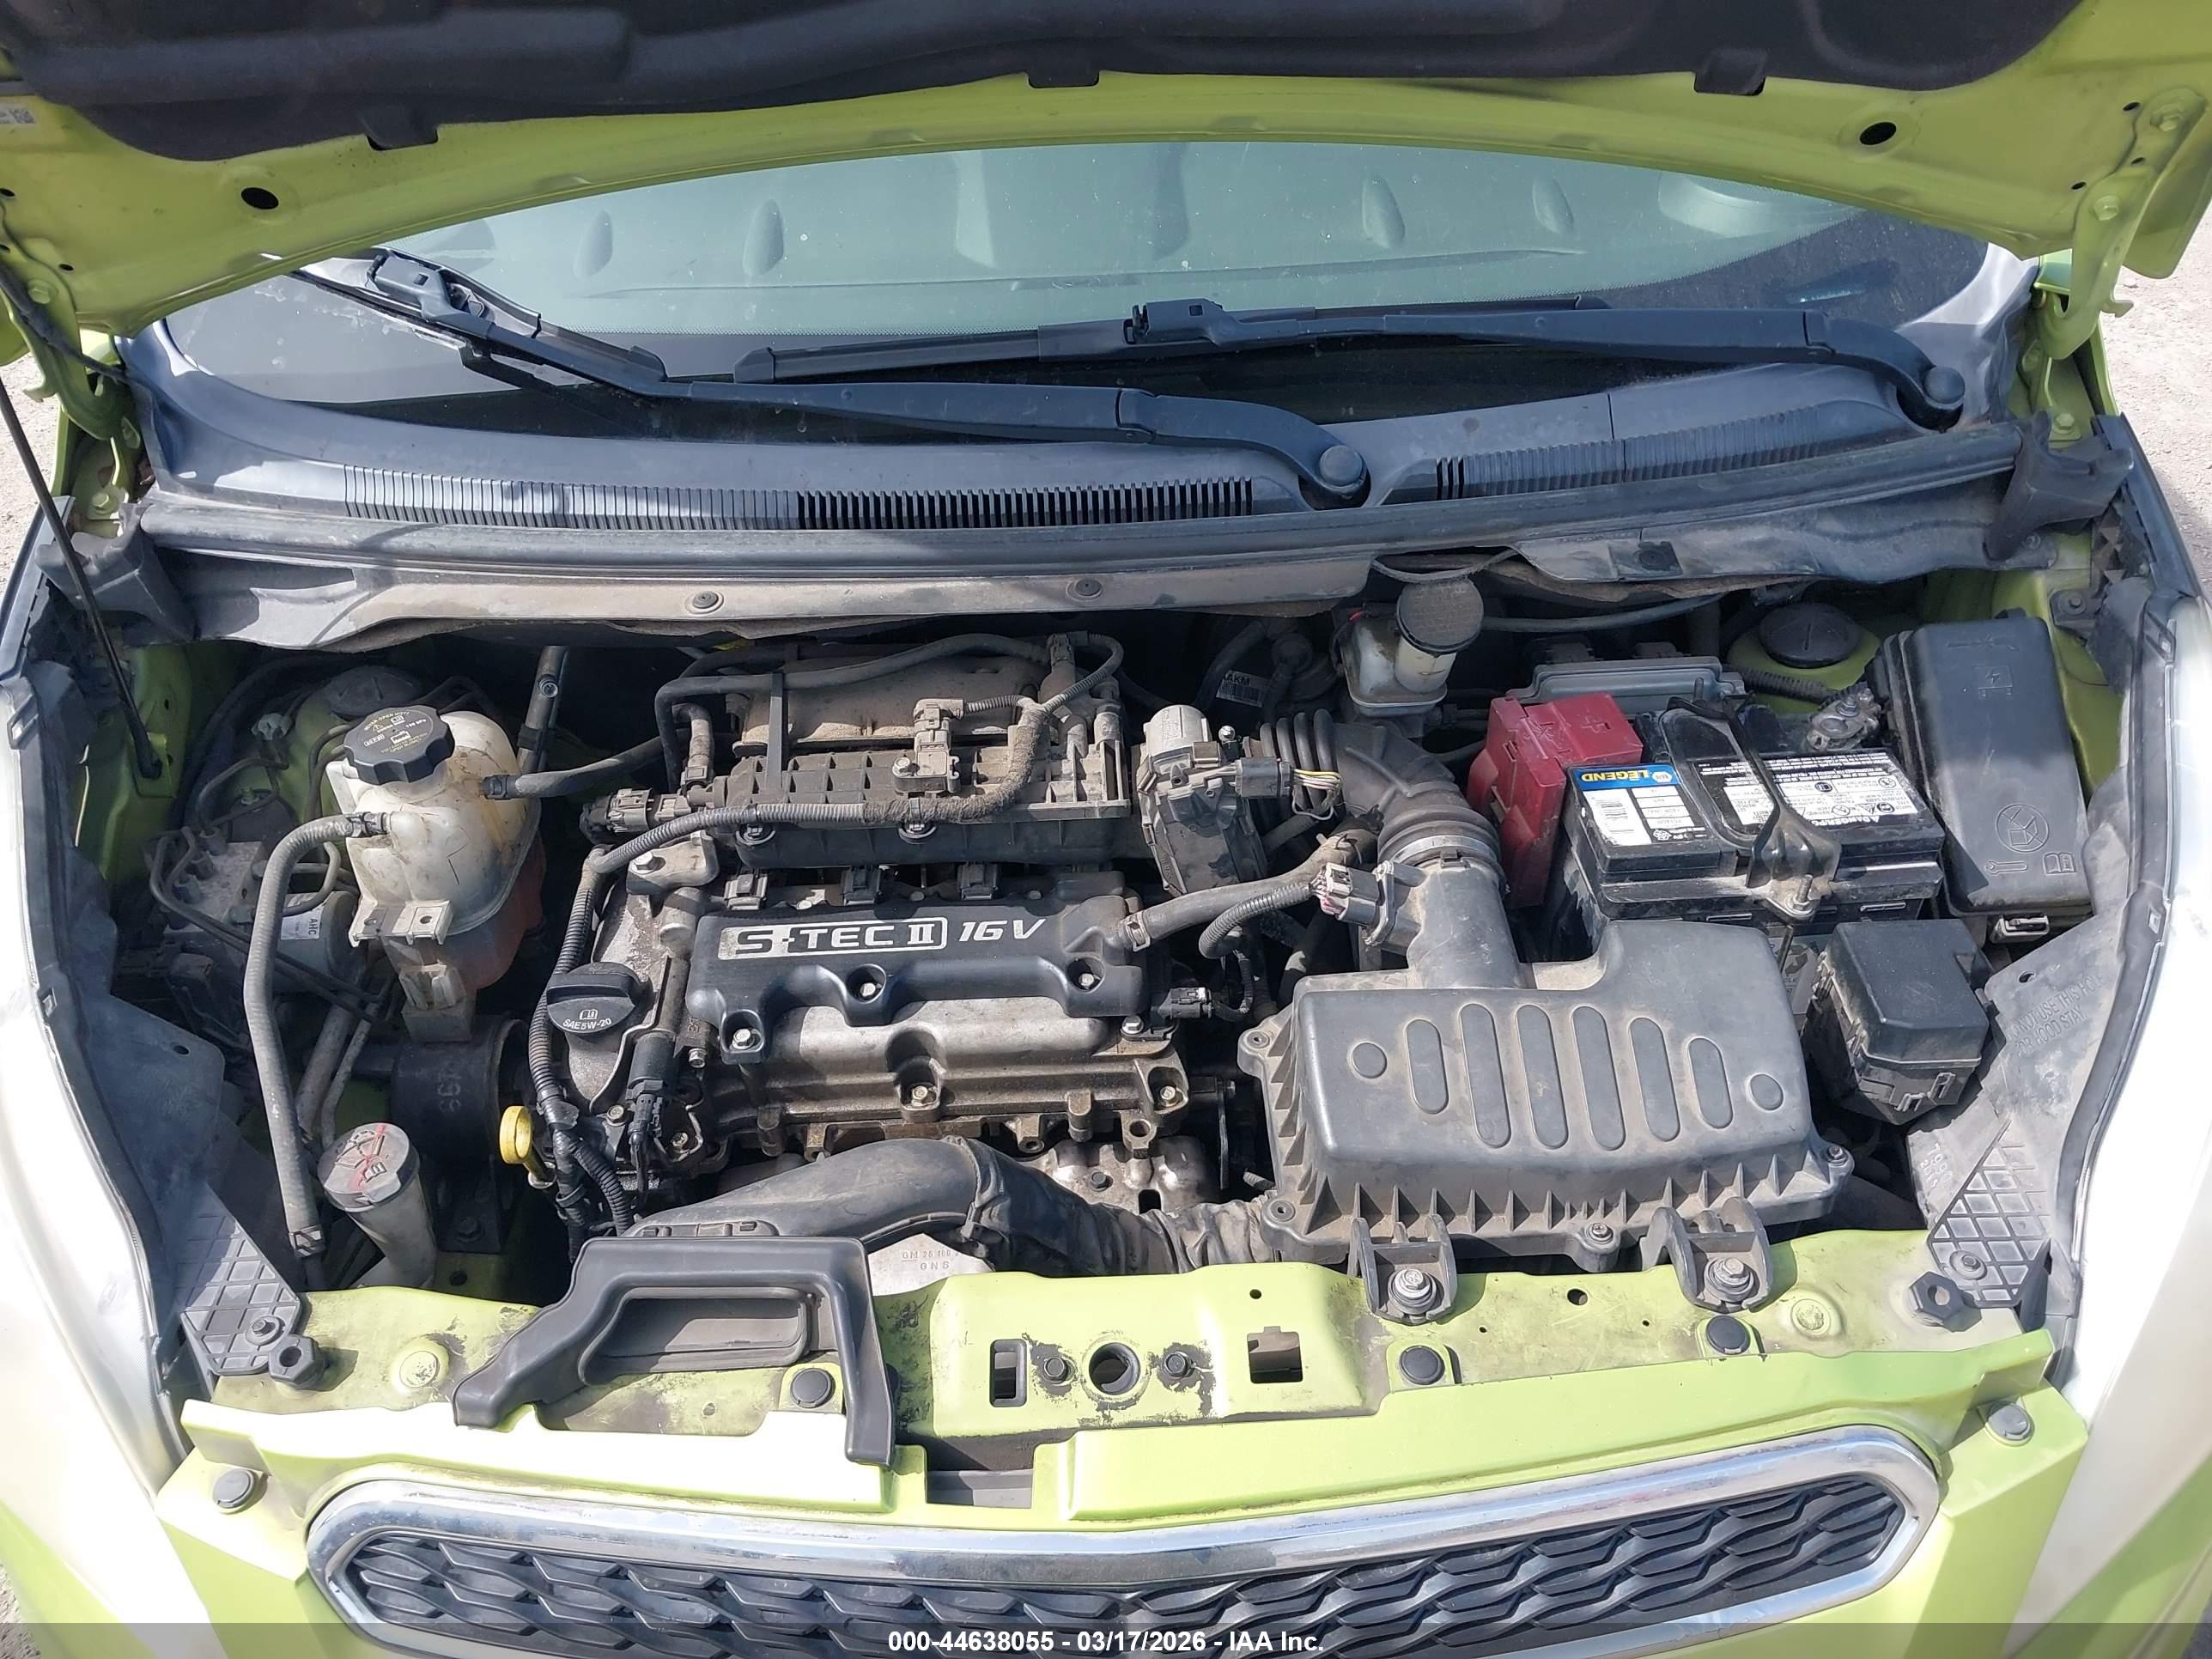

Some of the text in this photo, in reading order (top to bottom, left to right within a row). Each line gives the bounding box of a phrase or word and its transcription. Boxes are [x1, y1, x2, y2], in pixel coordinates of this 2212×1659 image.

[1581, 769, 1650, 782] LEGEND
[308, 918, 319, 935] AHC
[735, 924, 895, 955] S-TEC
[958, 918, 1047, 942] 16V
[2018, 1009, 2039, 1032] NOT
[2038, 998, 2060, 1020] USE
[2055, 985, 2081, 1010] THIS
[2034, 1019, 2062, 1046] HOOD
[902, 1250, 919, 1260] GM
